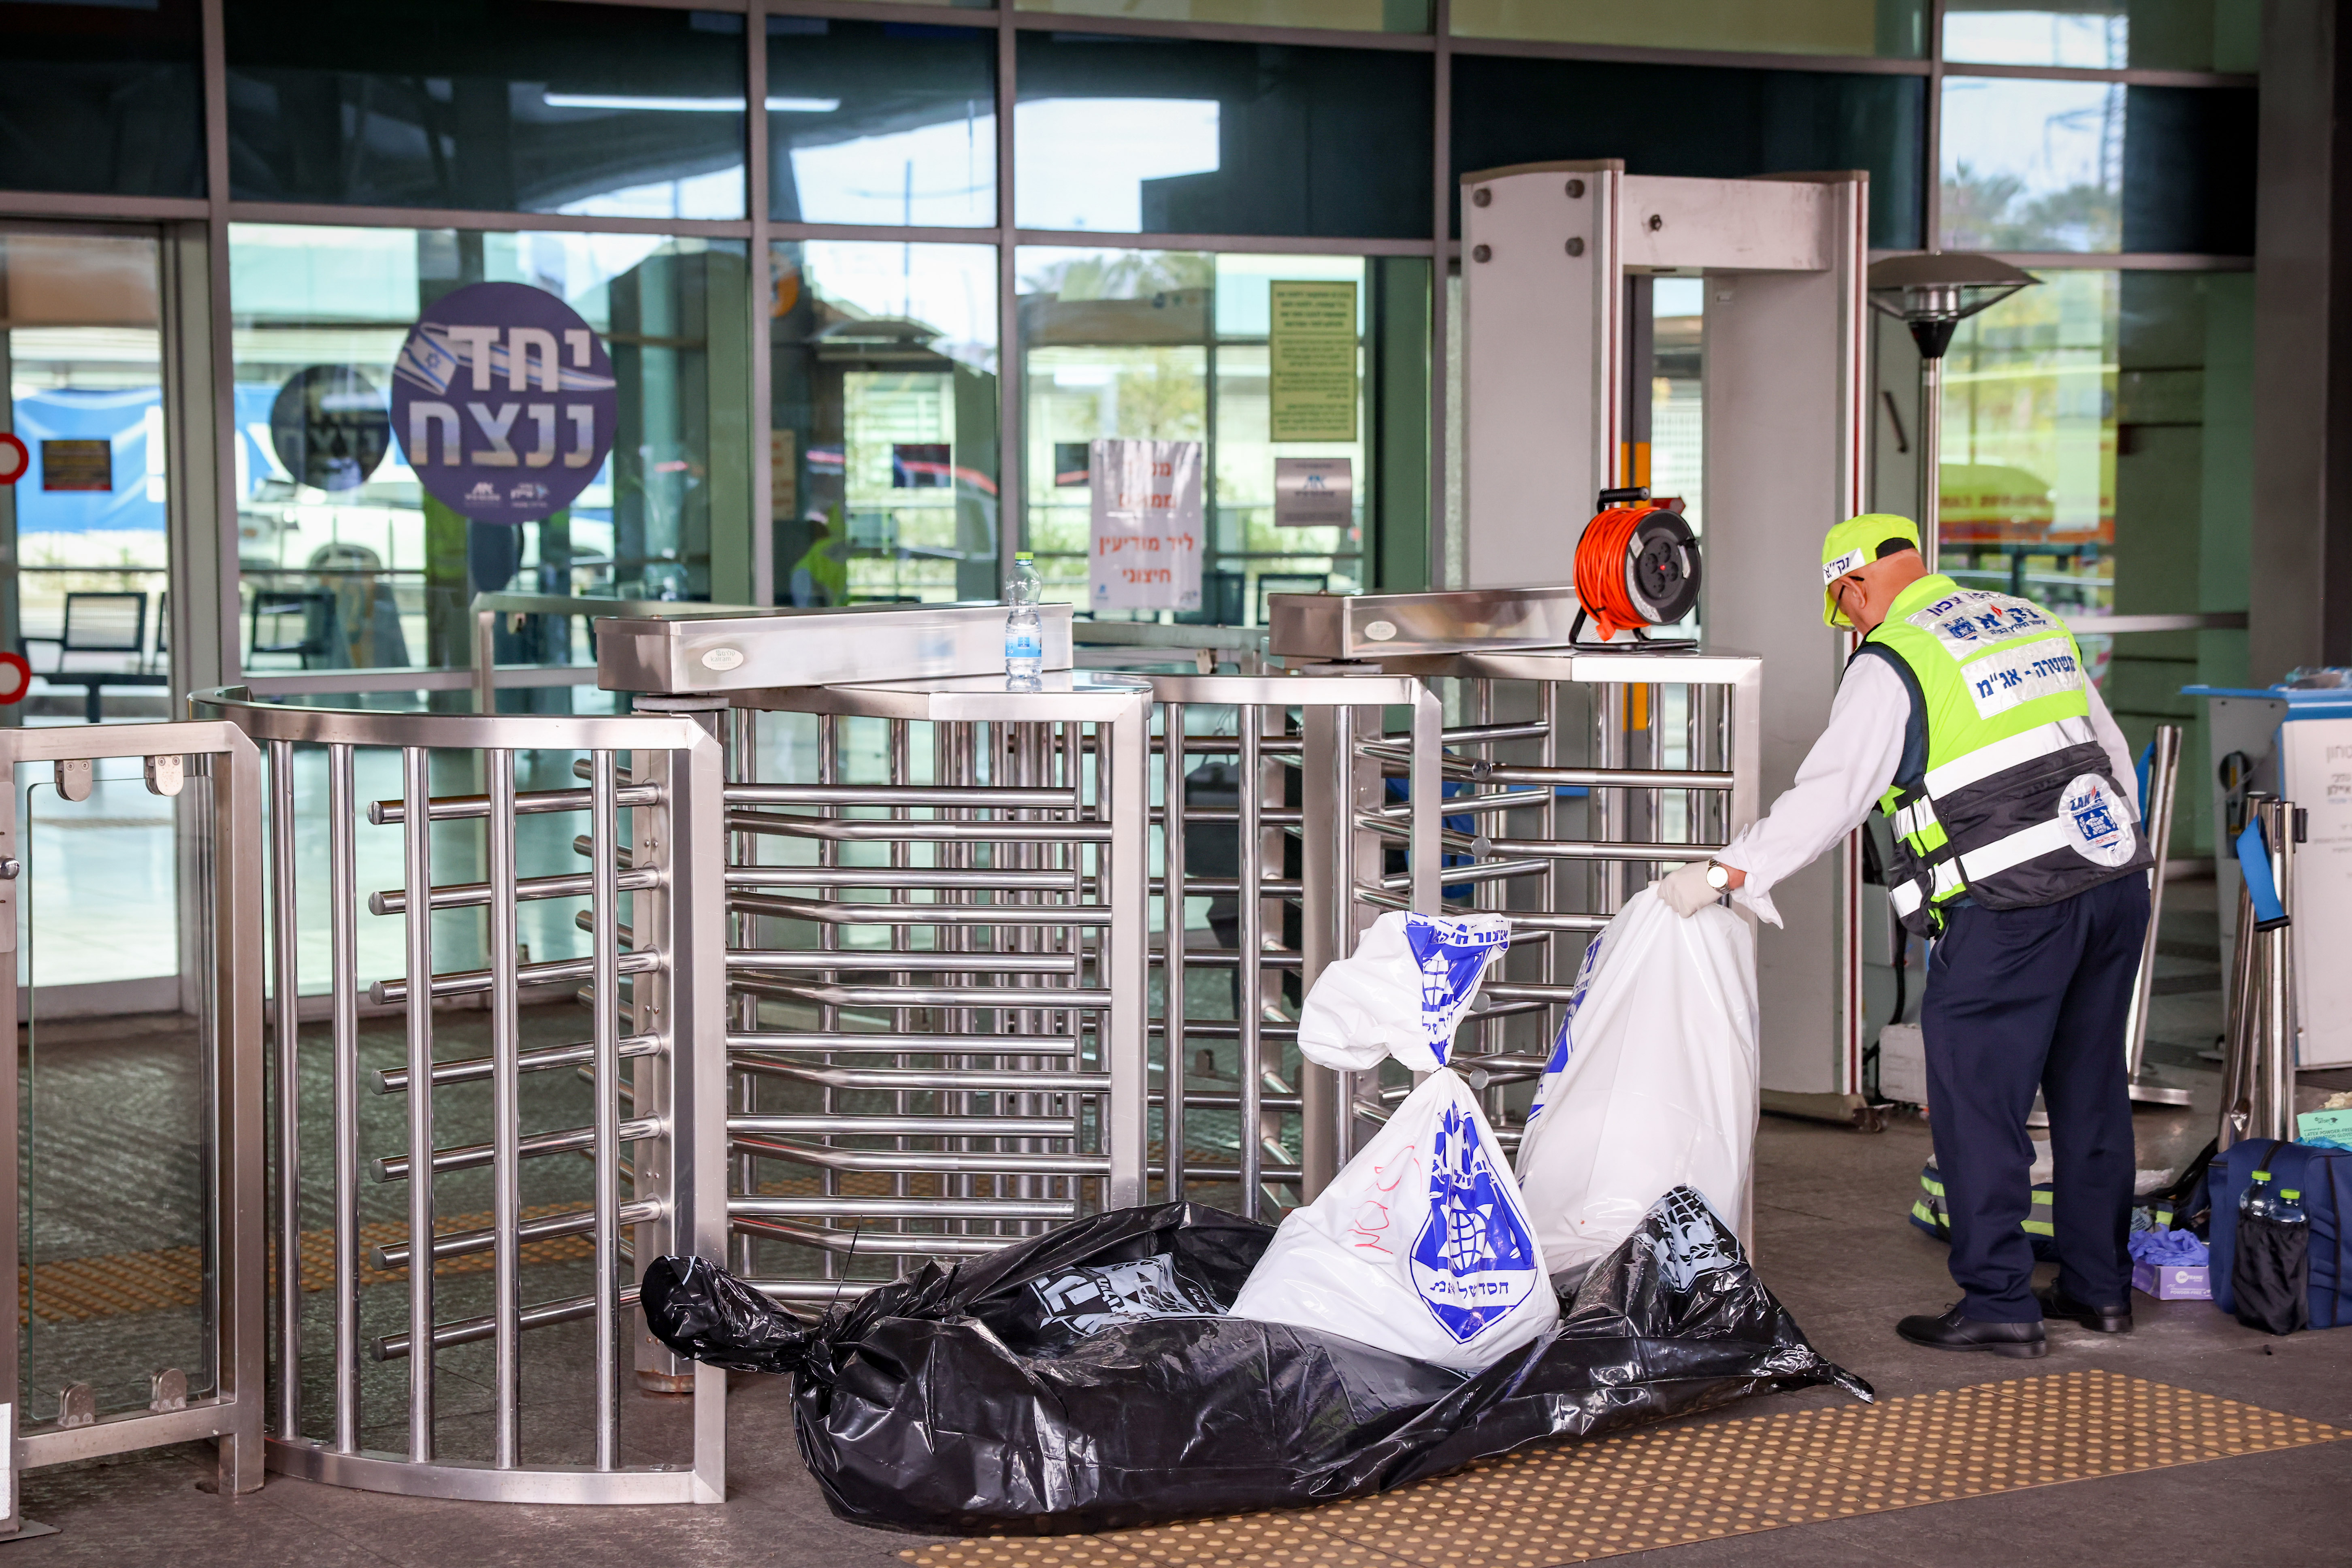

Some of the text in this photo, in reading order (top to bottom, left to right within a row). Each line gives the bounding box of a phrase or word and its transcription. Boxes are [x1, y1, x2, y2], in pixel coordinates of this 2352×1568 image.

[448, 326, 591, 392] יחד
[409, 401, 595, 469] ננצח
[1099, 532, 1193, 556] ליד מודיעין
[1122, 568, 1172, 583] חיצוני
[1479, 1282, 1508, 1295] חסד
